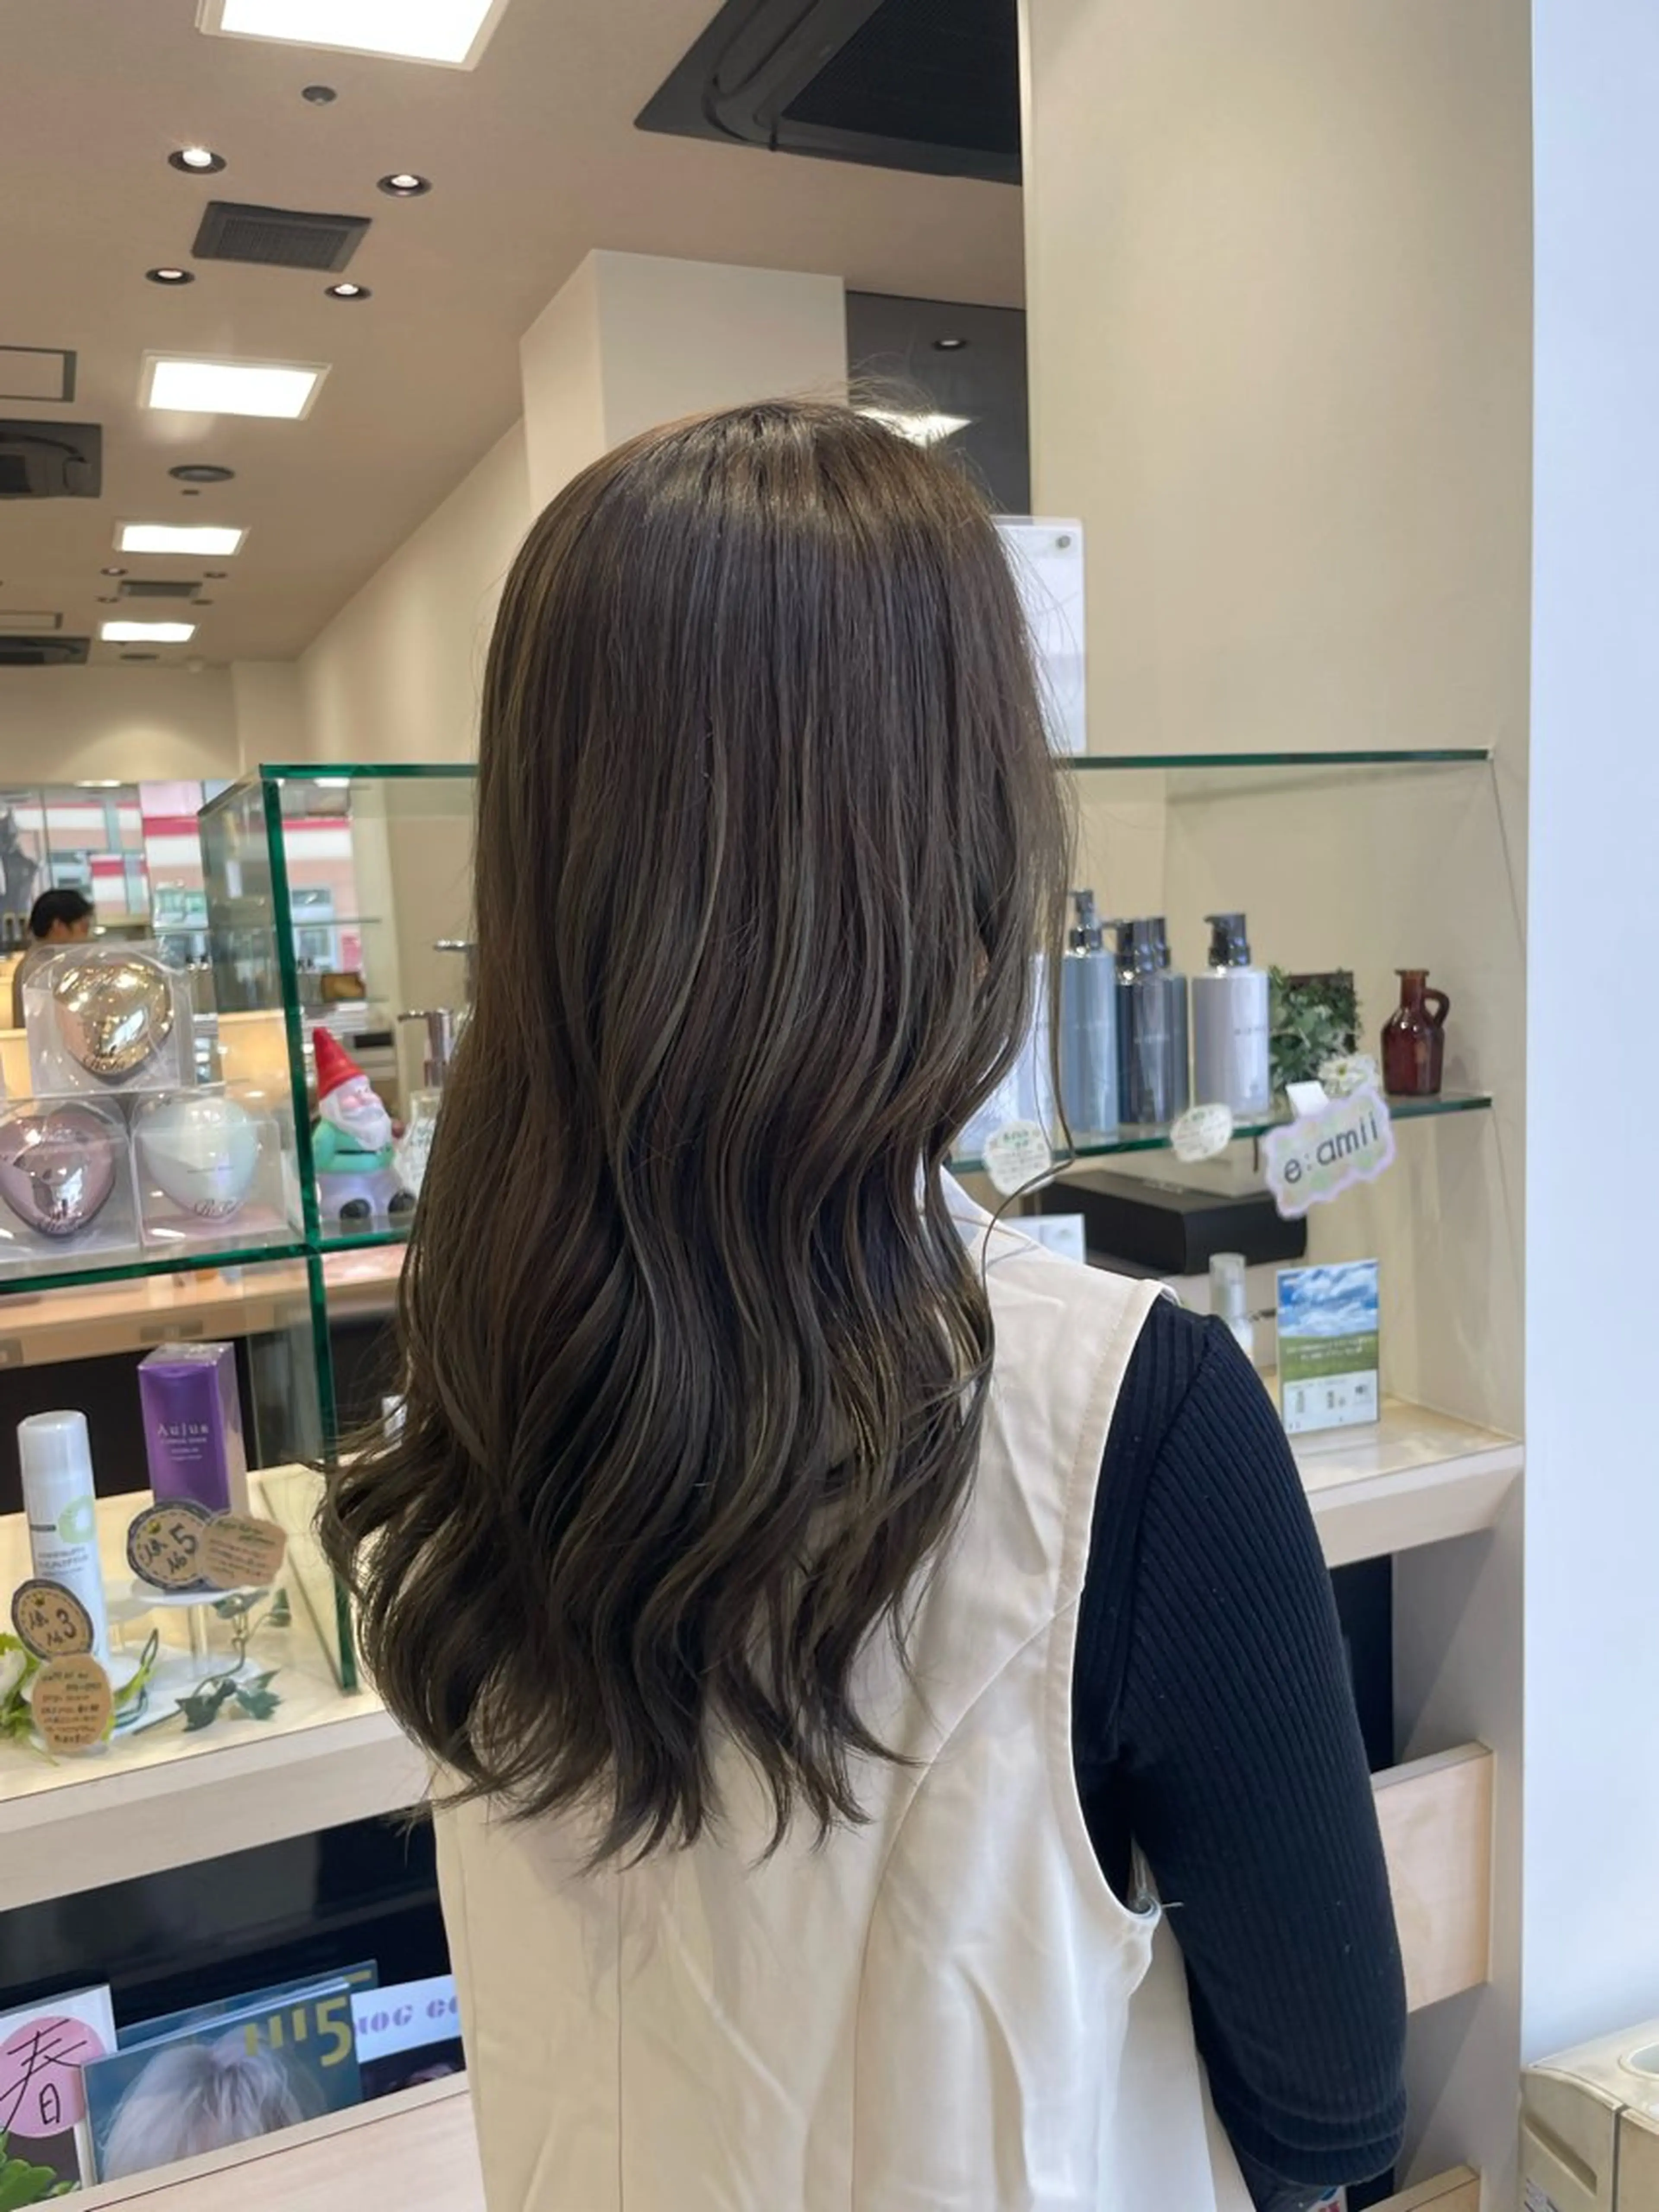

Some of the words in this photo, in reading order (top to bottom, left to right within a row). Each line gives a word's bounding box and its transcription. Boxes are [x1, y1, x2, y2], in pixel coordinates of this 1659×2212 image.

[168, 1522, 199, 1555] 5
[56, 1607, 77, 1640] 3
[0, 2018, 88, 2134] 春
